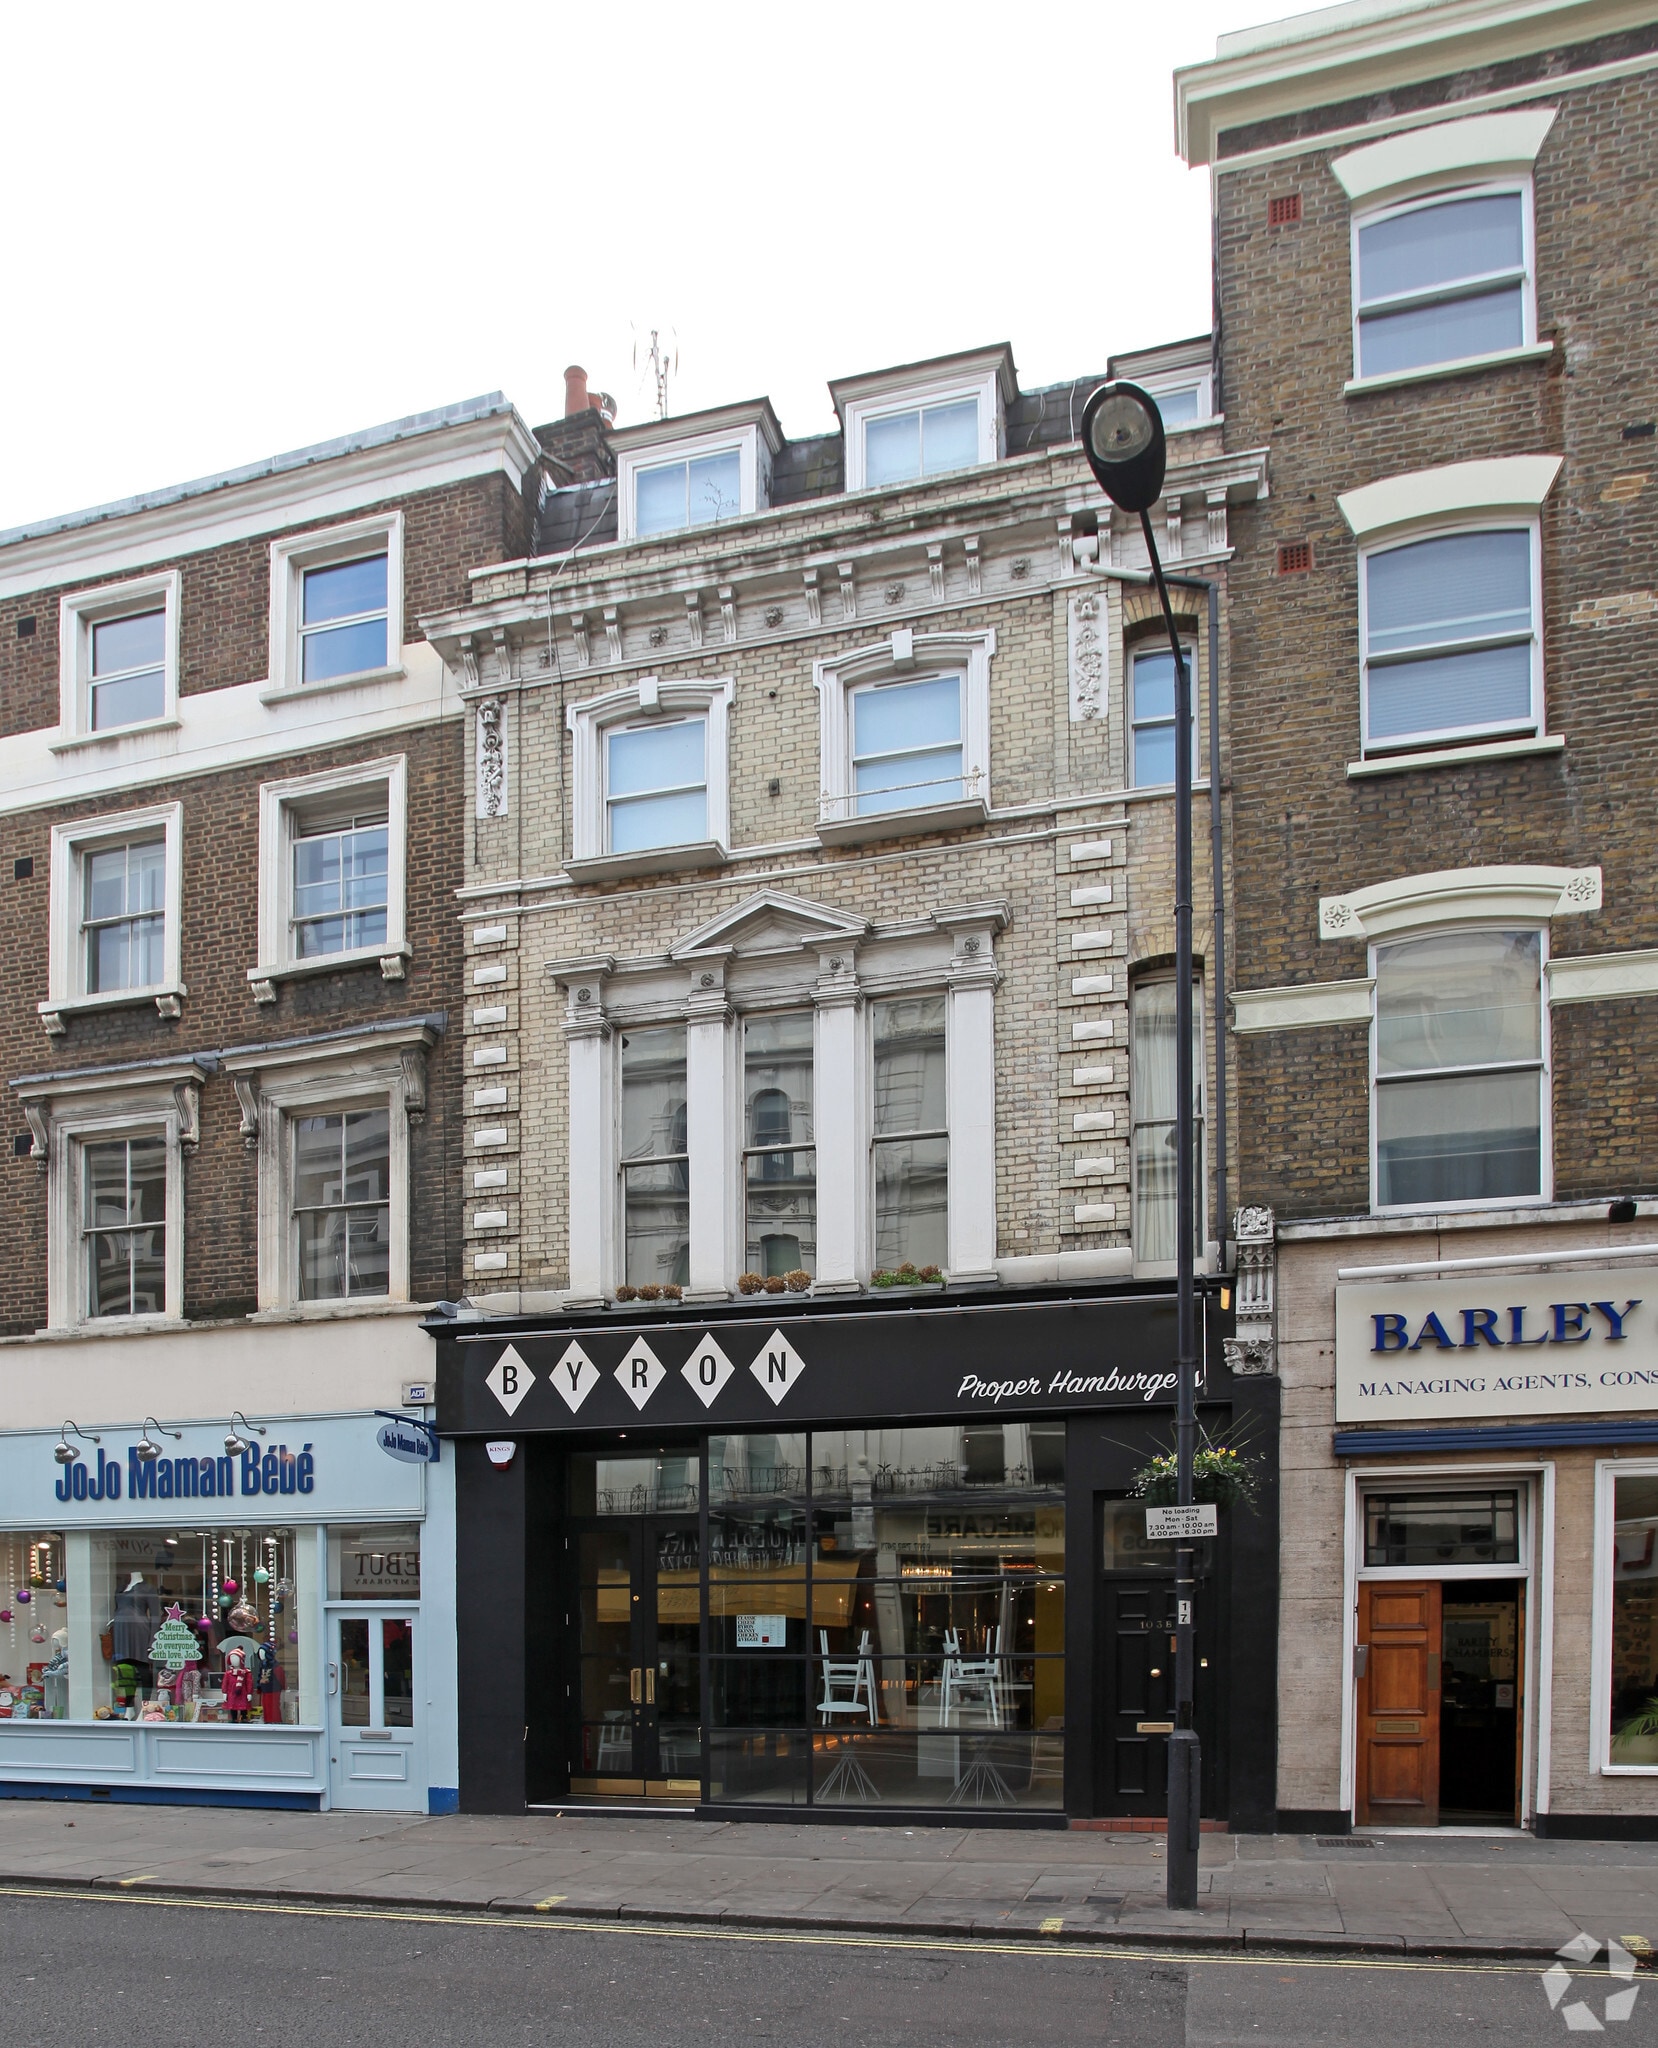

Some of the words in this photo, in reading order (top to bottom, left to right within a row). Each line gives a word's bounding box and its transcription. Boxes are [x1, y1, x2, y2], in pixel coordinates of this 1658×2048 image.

[1370, 1299, 1643, 1353] BARLEY
[502, 1351, 787, 1395] BYRON
[410, 1389, 425, 1398] ADT
[957, 1373, 1041, 1404] Proper
[1048, 1366, 1204, 1402] Hamburge
[1358, 1377, 1486, 1398] MANAGING
[1492, 1372, 1593, 1392] AGENTS,
[55, 1447, 122, 1502] JoJo
[128, 1445, 233, 1499] Maman
[240, 1440, 315, 1496] Bébé
[158, 1632, 193, 1640] Christmas
[165, 1623, 185, 1633] Merry
[152, 1651, 167, 1659] with
[156, 1642, 163, 1650] to
